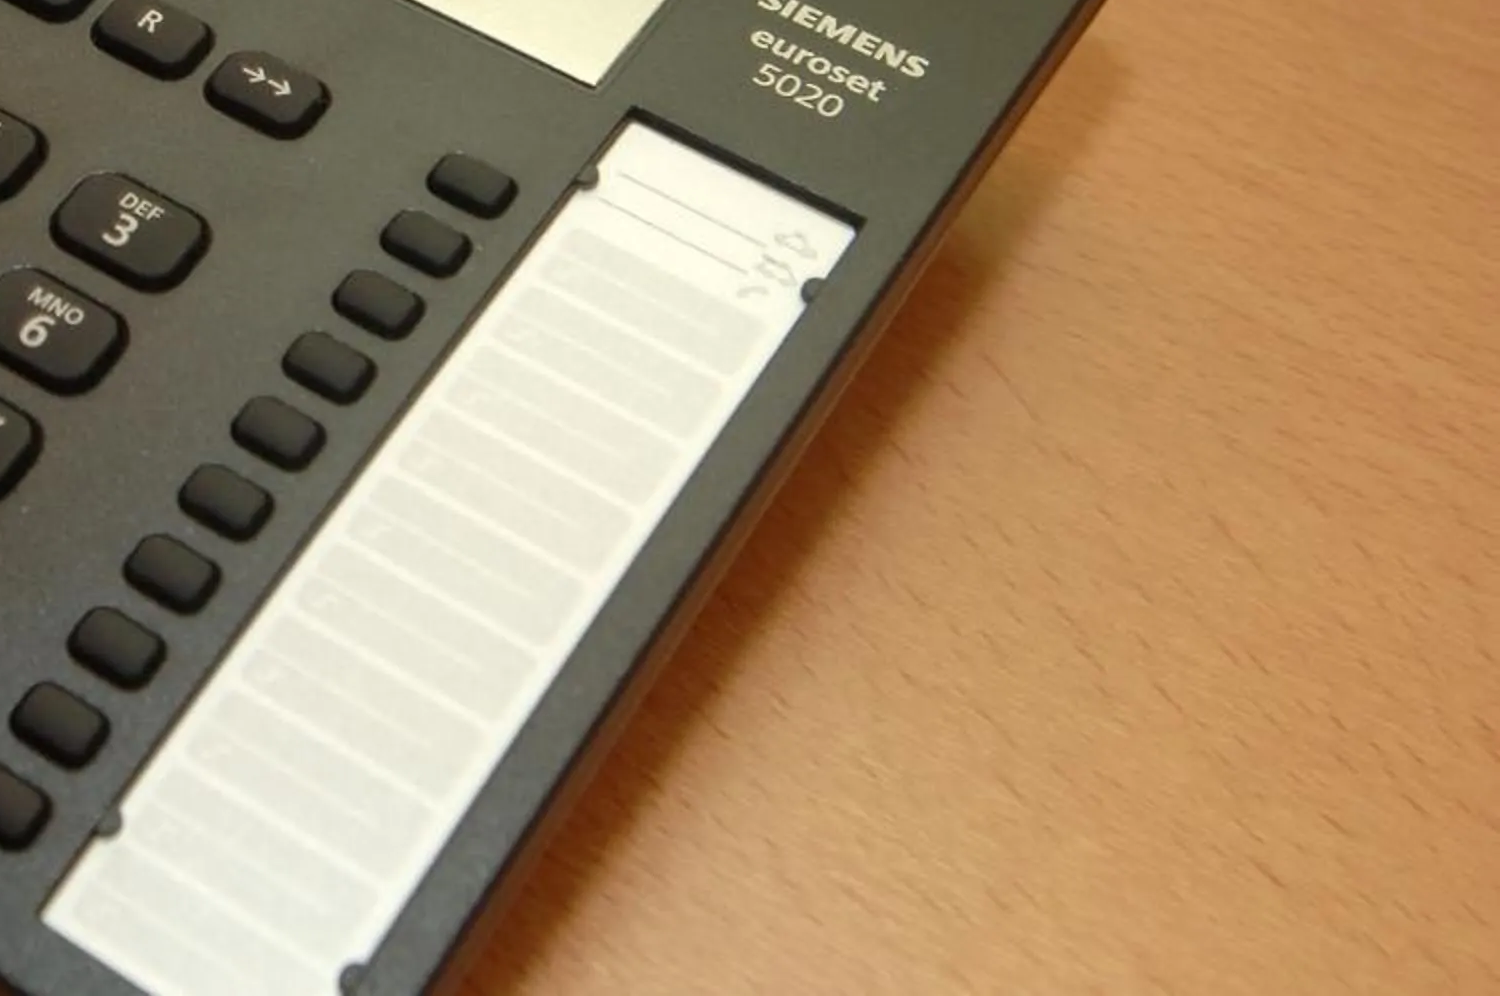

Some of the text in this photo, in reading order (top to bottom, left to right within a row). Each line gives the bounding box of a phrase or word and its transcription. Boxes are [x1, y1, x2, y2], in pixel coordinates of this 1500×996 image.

[136, 8, 164, 34] R
[750, 29, 887, 102] euroset
[751, 63, 845, 117] 5020
[117, 191, 166, 222] DEF
[101, 212, 140, 248] 3
[26, 285, 86, 326] MNO
[18, 314, 57, 349] 6
